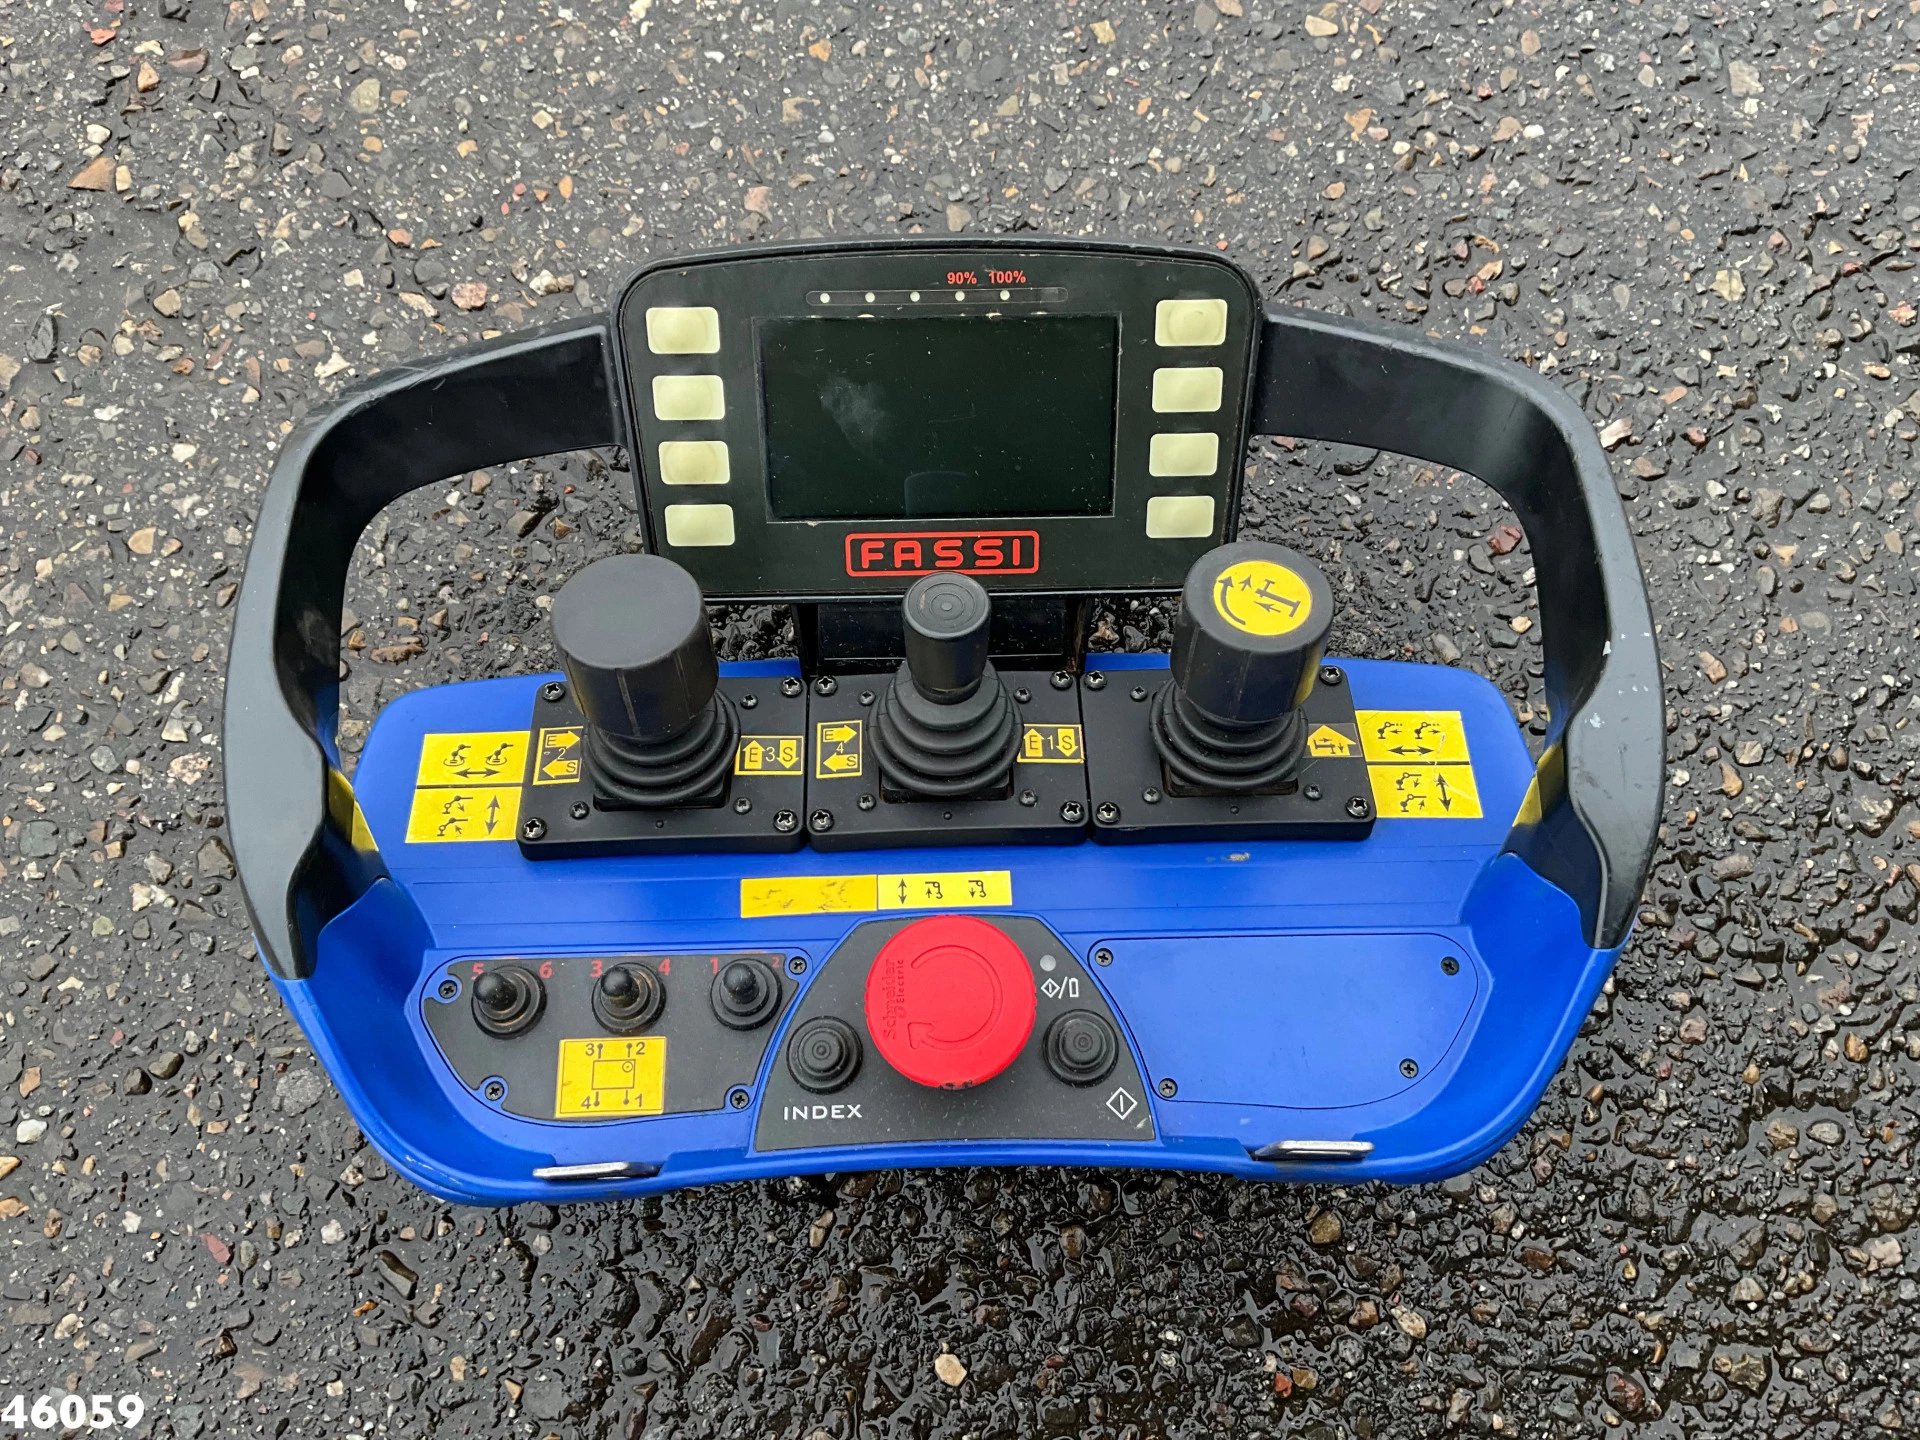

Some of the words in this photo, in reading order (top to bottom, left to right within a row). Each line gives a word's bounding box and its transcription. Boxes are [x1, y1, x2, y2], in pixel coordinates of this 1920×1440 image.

[947, 271, 977, 285] 90%
[988, 270, 1026, 284] 100%
[860, 539, 1023, 569] FASSI
[547, 734, 557, 747] E
[824, 729, 834, 740] E
[836, 742, 844, 754] 4
[1030, 736, 1038, 750] E
[1047, 735, 1054, 749] 1
[1061, 734, 1073, 751] S
[557, 748, 566, 760] 2
[749, 747, 759, 762] E
[765, 746, 776, 762] 3
[782, 746, 793, 763] S
[846, 754, 857, 767] S
[565, 760, 577, 773] S
[471, 962, 484, 980] 5
[539, 961, 553, 978] 6
[590, 959, 603, 977] 3
[658, 958, 671, 976] 4
[709, 957, 719, 973] 1
[772, 957, 780, 968] 2
[897, 958, 905, 1004] Electric
[883, 958, 898, 1040] Schneider
[585, 1042, 595, 1056] 3
[636, 1041, 646, 1055] 2
[580, 1095, 591, 1110] 4
[635, 1095, 643, 1107] 1
[783, 1104, 862, 1121] INDEX
